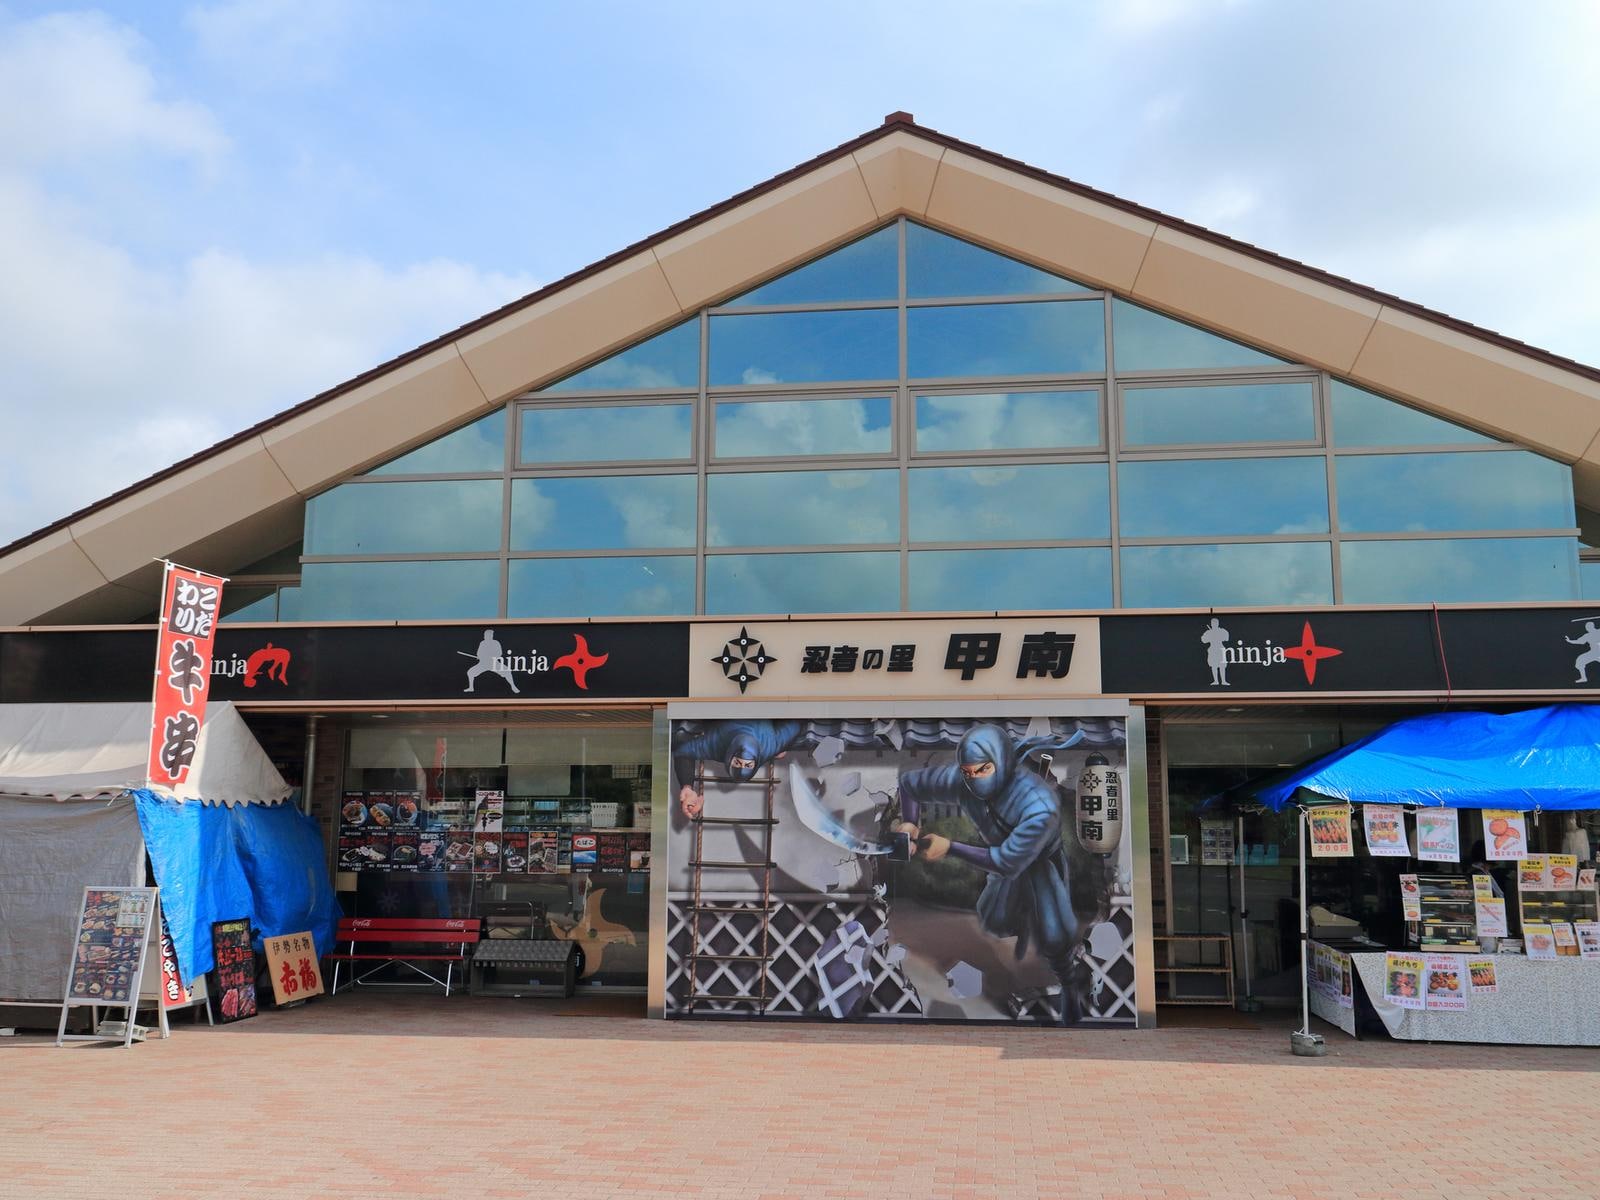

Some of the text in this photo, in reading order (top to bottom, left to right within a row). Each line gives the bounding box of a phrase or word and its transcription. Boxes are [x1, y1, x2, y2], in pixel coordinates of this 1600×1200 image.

[492, 649, 550, 675] ninja
[801, 631, 1076, 681] 忍者の里 甲南
[1221, 639, 1288, 667] ninja
[159, 637, 205, 782] 牛串
[1080, 795, 1103, 841] 甲南
[1104, 771, 1119, 821] 忍者の里
[273, 936, 311, 956] 伊勢名物
